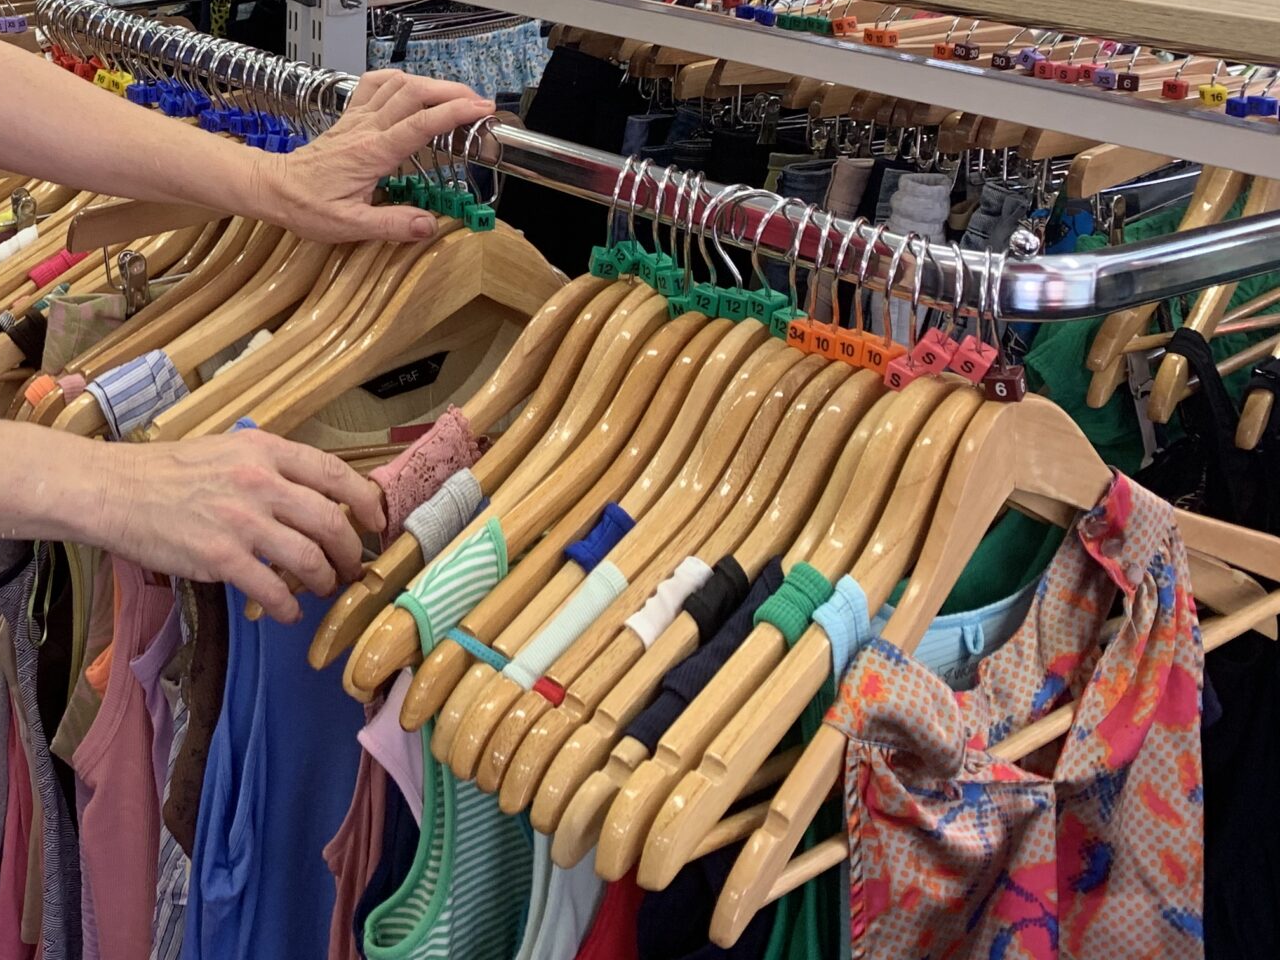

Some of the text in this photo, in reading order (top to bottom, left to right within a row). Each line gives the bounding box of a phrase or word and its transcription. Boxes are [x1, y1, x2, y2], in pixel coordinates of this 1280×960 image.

[875, 34, 883, 43] 10
[889, 34, 897, 43] 10
[936, 46, 946, 56] 10
[955, 46, 966, 57] 30
[993, 56, 1006, 66] 30
[1039, 66, 1046, 75] S
[1060, 70, 1068, 79] S
[1083, 69, 1091, 79] S
[97, 74, 106, 84] 16
[112, 79, 120, 90] 16
[1098, 76, 1110, 85] XS
[1123, 79, 1132, 89] 6
[1210, 93, 1223, 102] 16
[445, 200, 453, 210] 12
[479, 217, 489, 227] M
[614, 248, 626, 261] 12
[598, 263, 613, 275] 12
[642, 265, 651, 280] 12
[658, 277, 666, 288] 12
[696, 295, 711, 310] 12
[726, 299, 741, 313] 12
[751, 301, 764, 316] 12
[775, 319, 787, 334] 12
[789, 326, 805, 344] 34
[815, 336, 830, 352] 10
[840, 341, 855, 357] 10
[867, 349, 882, 366] 10
[922, 352, 936, 365] S
[960, 360, 975, 374] S
[398, 369, 419, 385] F&F
[890, 373, 901, 388] S
[995, 382, 1007, 397] 6
